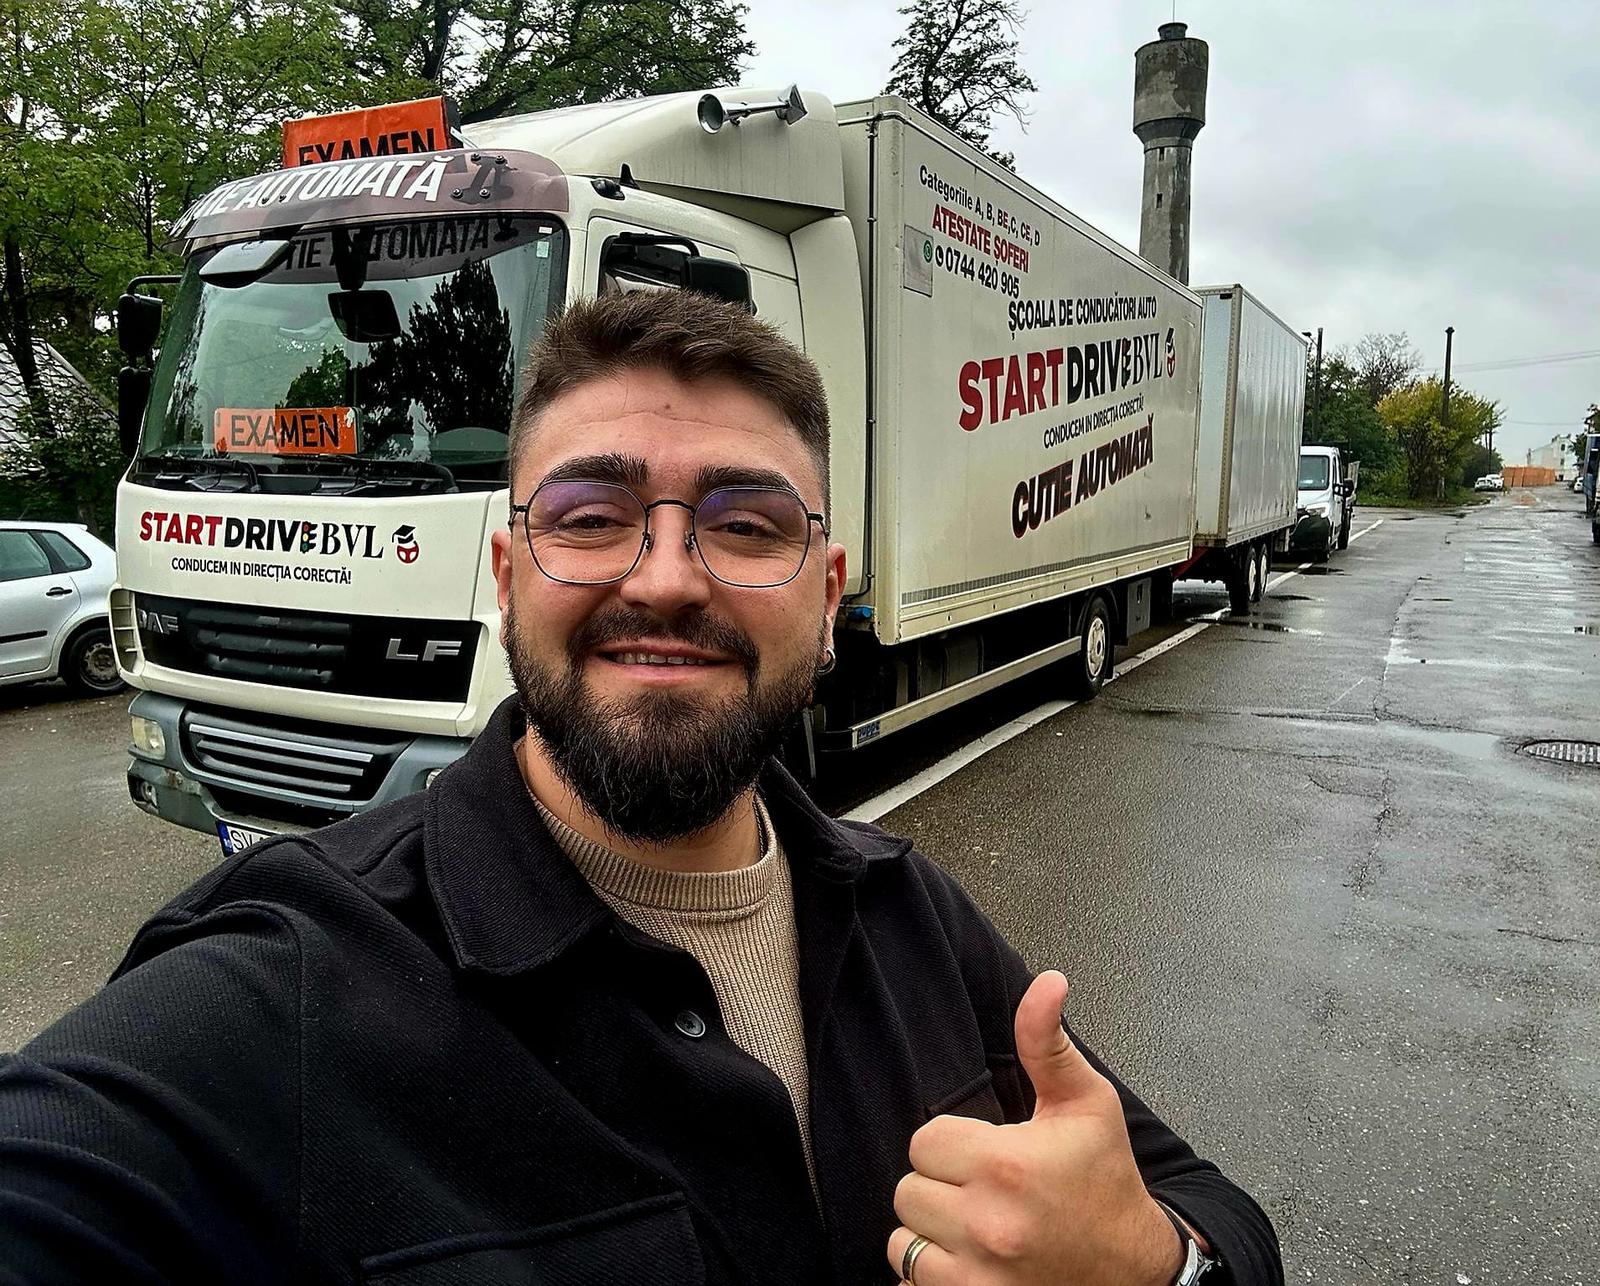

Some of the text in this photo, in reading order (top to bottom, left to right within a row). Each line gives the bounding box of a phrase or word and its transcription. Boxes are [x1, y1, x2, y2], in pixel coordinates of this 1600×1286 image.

[232, 155, 455, 211] AUTOMATĂ
[920, 164, 974, 210] Categoriile
[1034, 230, 1041, 246] D
[932, 204, 1029, 273] ATESTATE ȘOFERI
[946, 247, 1019, 299] 0744 420 905
[1008, 291, 1157, 340] ȘCOALA DE CONDUCĂTORI AUTO
[231, 413, 339, 448] EXAMEN
[1043, 417, 1085, 449] CONDUCEM
[1085, 412, 1094, 434] IN
[1012, 412, 1154, 538] CUTIE AUTOMATĂ
[171, 557, 352, 585] CONDUCEM IN DIRECȚIA CORECTĂ!
[386, 638, 462, 661] LF
